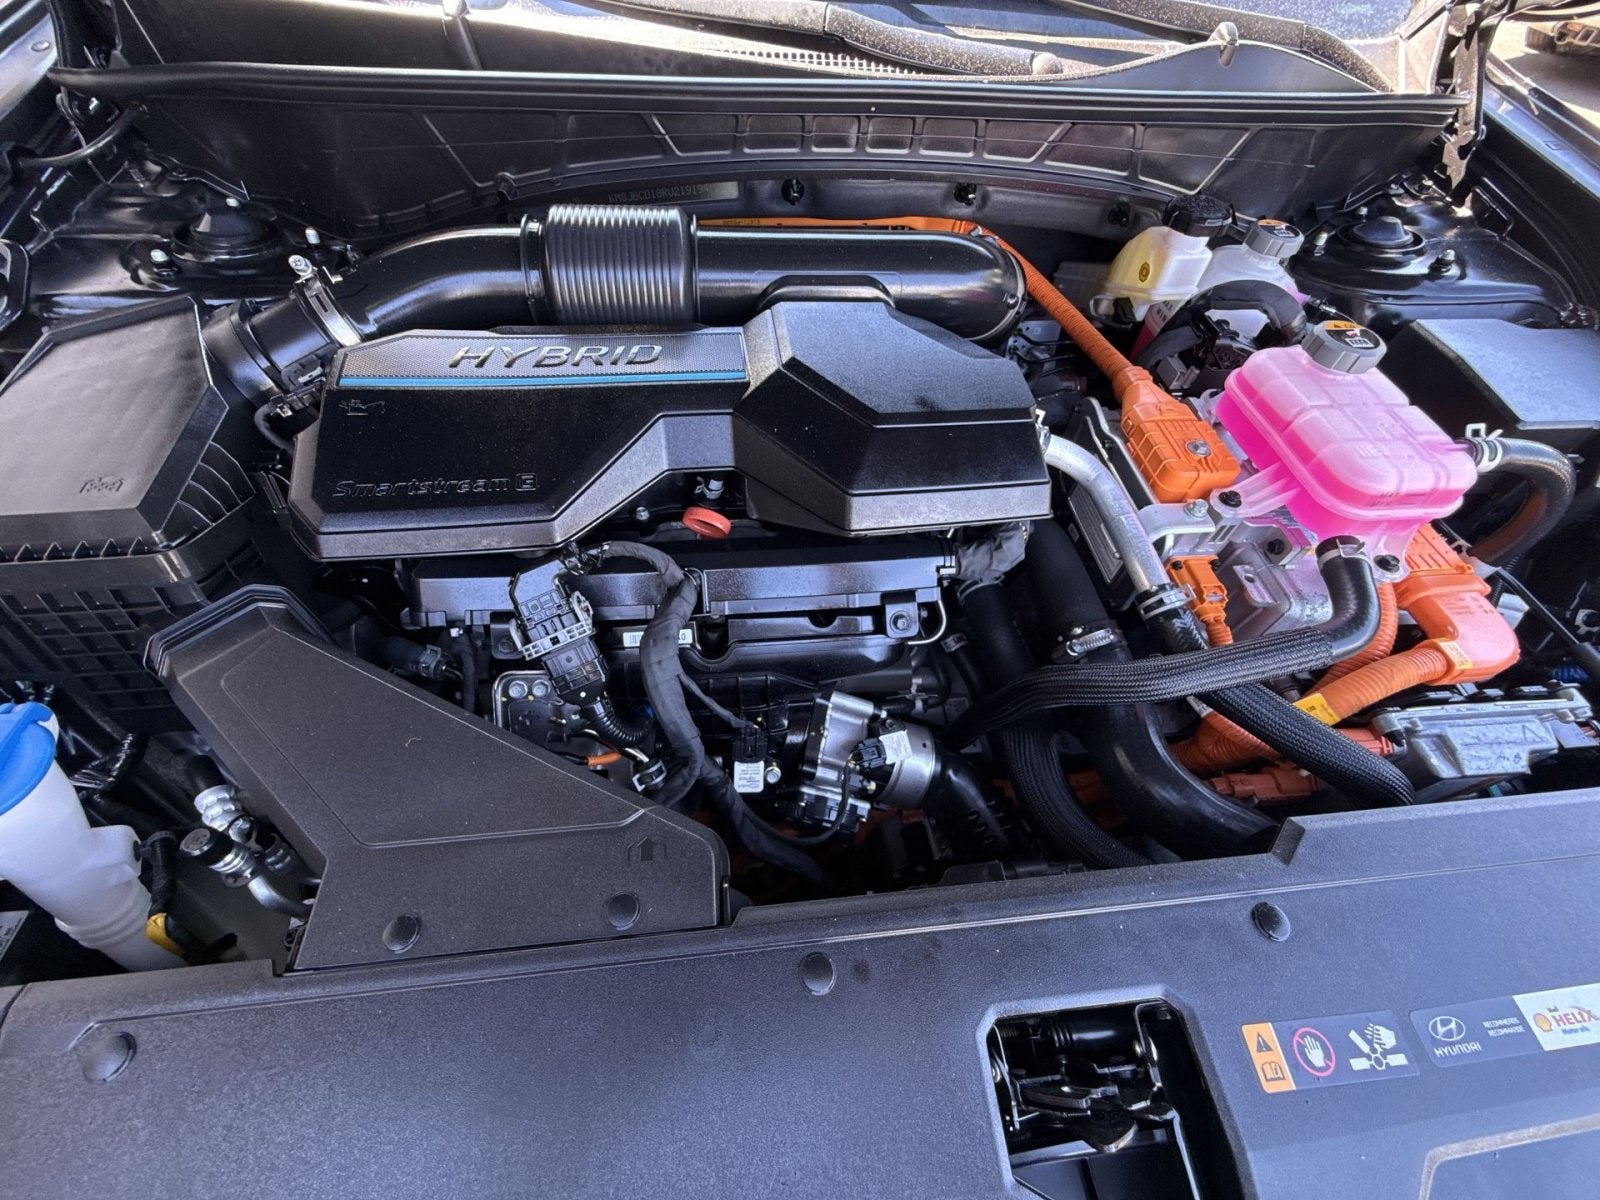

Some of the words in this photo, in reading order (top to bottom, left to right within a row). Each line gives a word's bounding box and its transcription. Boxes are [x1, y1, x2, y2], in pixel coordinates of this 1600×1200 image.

[447, 343, 664, 369] HYBRID
[332, 477, 511, 498] Smartstream
[1550, 1008, 1598, 1027] HELIX
[1433, 1041, 1483, 1058] HYUNDAI
